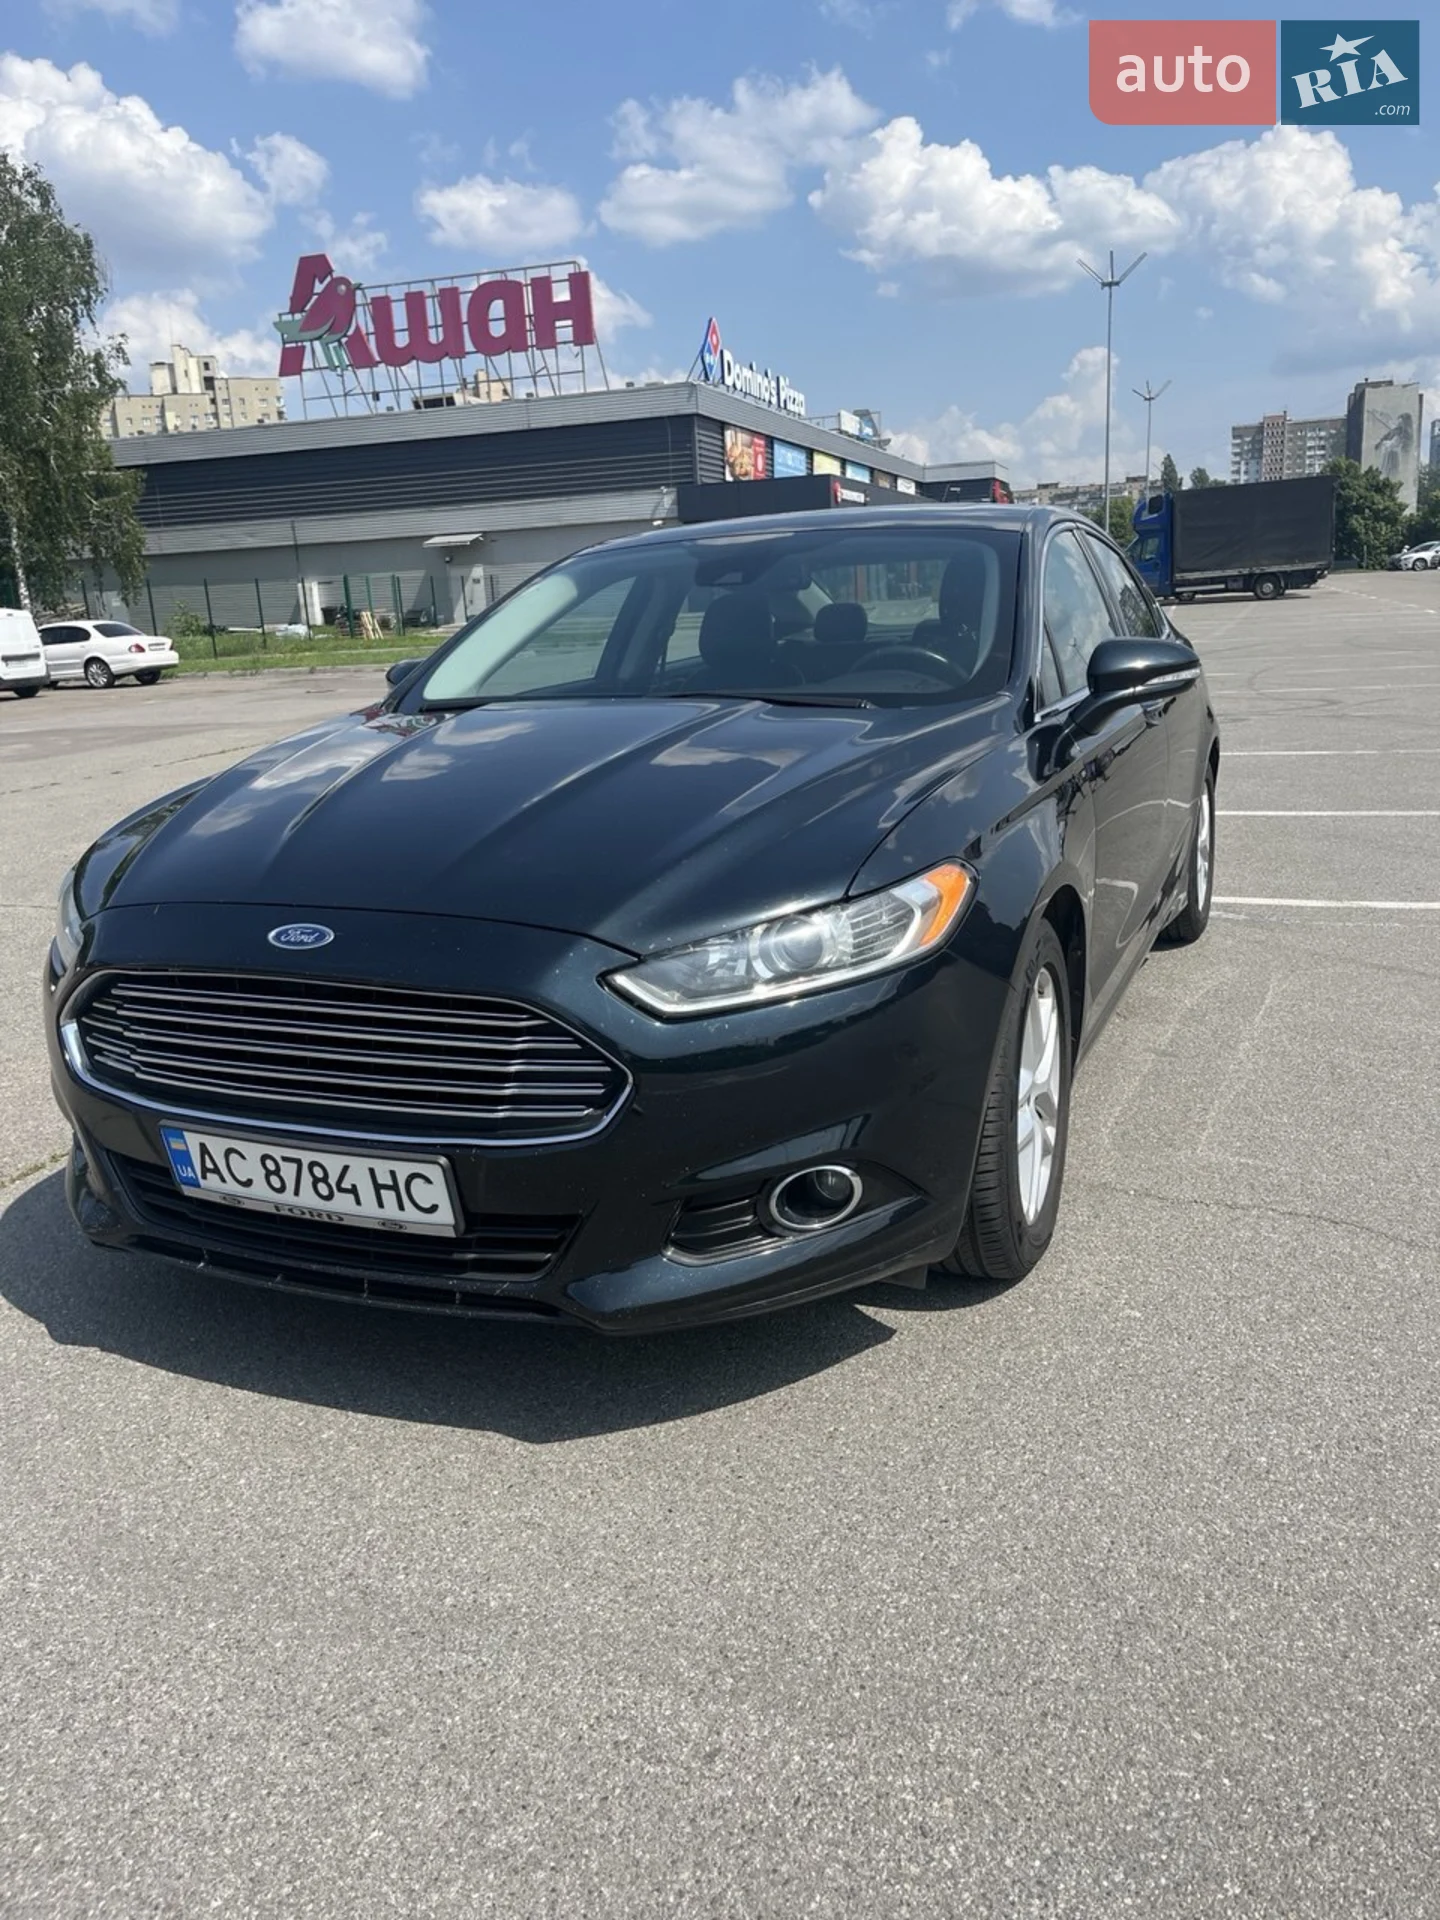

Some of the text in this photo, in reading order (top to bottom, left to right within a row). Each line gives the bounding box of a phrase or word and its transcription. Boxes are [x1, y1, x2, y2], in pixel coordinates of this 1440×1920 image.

[720, 348, 805, 417] Domino's Pizza
[176, 1164, 197, 1180] UA
[198, 1142, 440, 1215] AC 8784 HC
[273, 1204, 345, 1222] FORD
